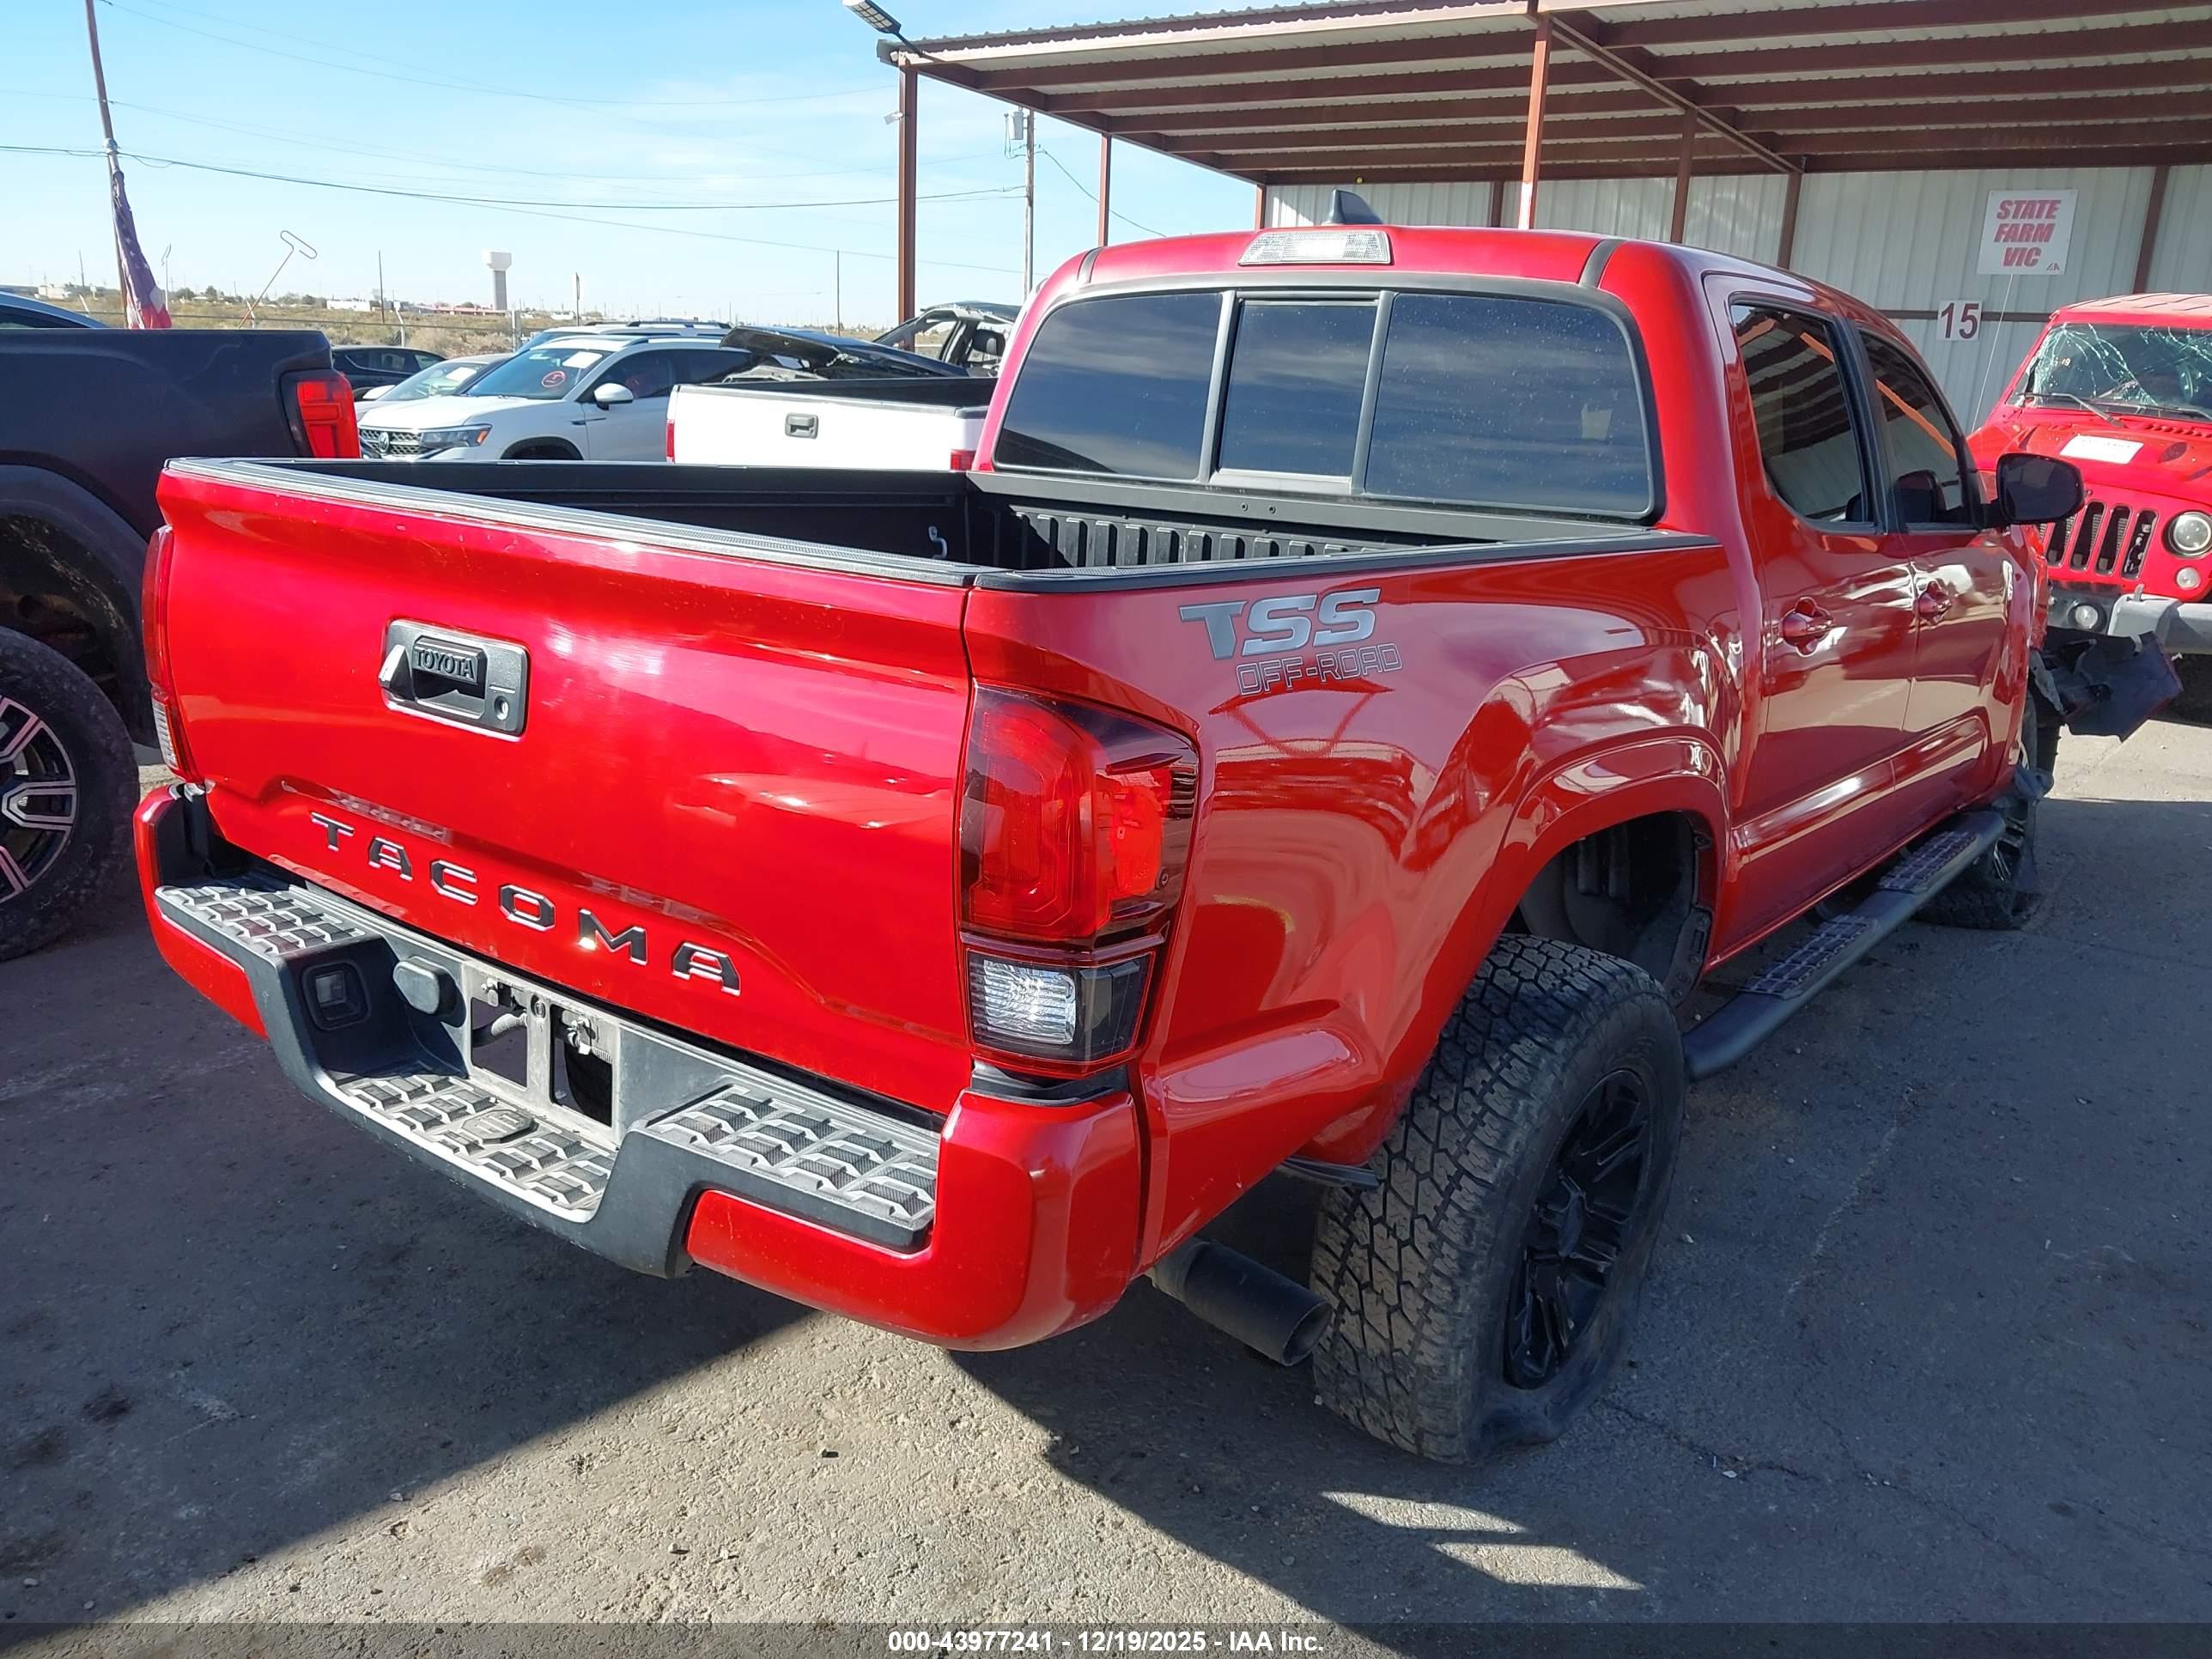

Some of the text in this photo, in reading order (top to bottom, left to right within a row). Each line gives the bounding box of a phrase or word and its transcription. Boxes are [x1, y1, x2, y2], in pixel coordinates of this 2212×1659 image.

[1996, 199, 2061, 219] STATE
[1994, 223, 2055, 242] FARM
[2003, 247, 2042, 266] VIC
[1942, 302, 1979, 339] 15
[1178, 588, 1381, 659] TSS
[416, 647, 475, 679] TOYOTA
[1236, 643, 1403, 696] OFF-ROAD
[311, 811, 741, 996] TACOMA
